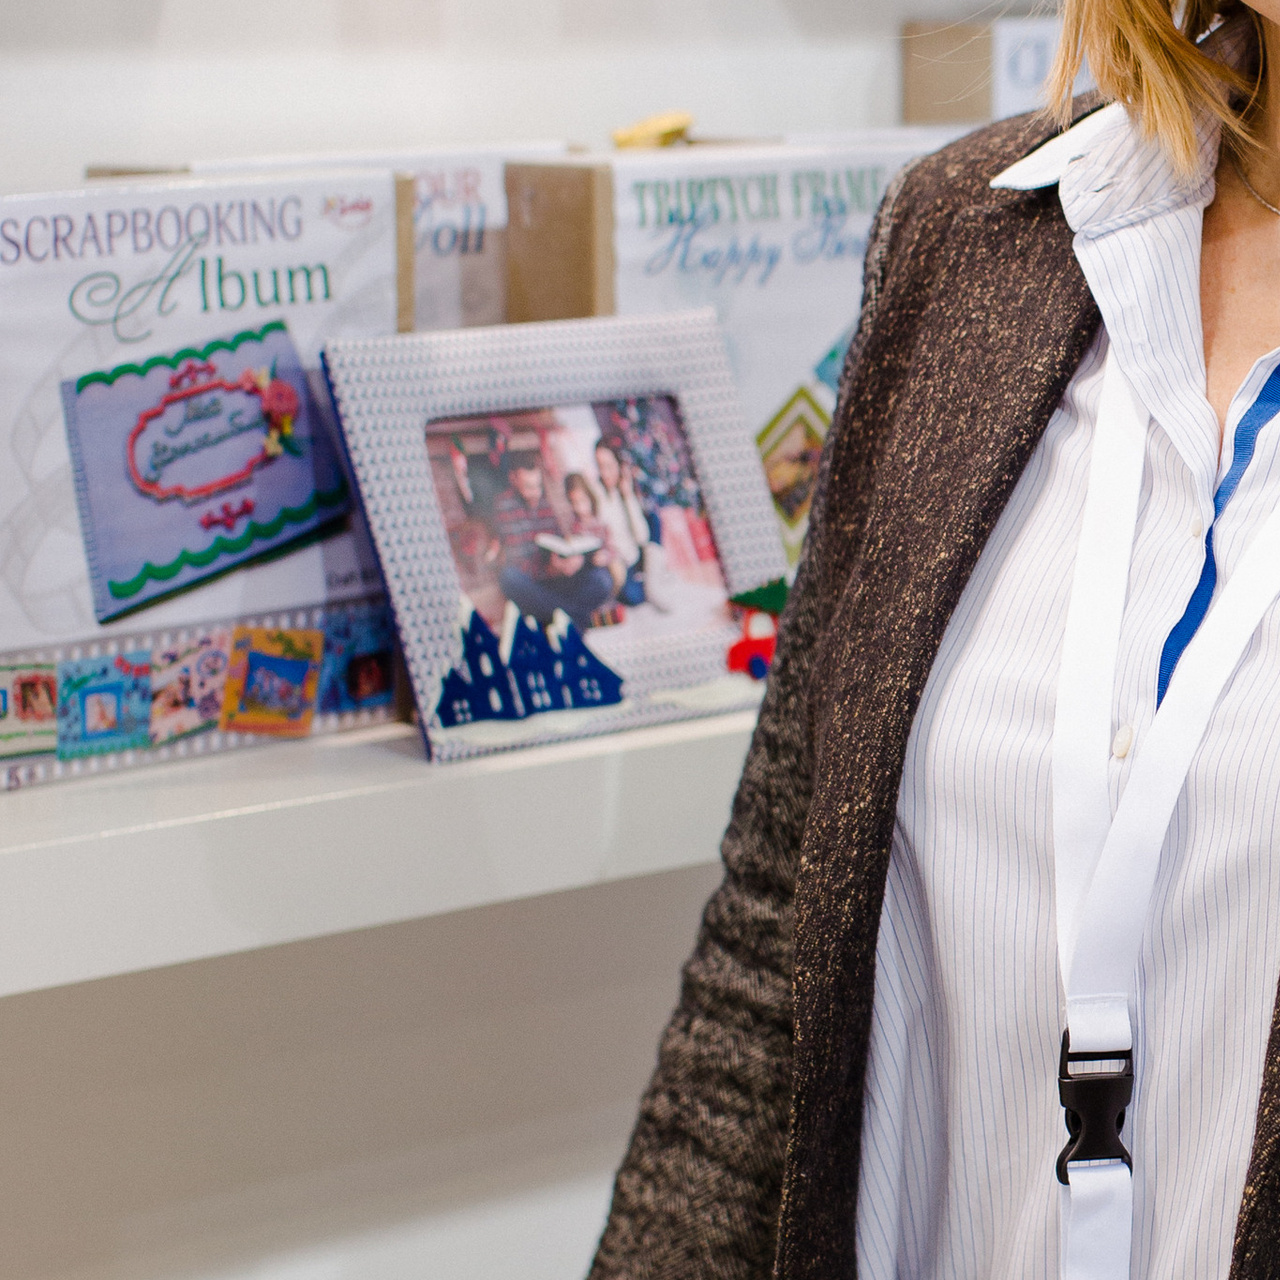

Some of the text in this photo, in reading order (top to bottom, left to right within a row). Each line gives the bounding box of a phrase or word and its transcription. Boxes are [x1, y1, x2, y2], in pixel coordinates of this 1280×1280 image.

[412, 169, 482, 211] OUR
[632, 173, 779, 227] TRIPTYCH
[0, 196, 304, 266] SCRAPBOOKING
[643, 200, 783, 290] Happy
[69, 229, 332, 344] Album
